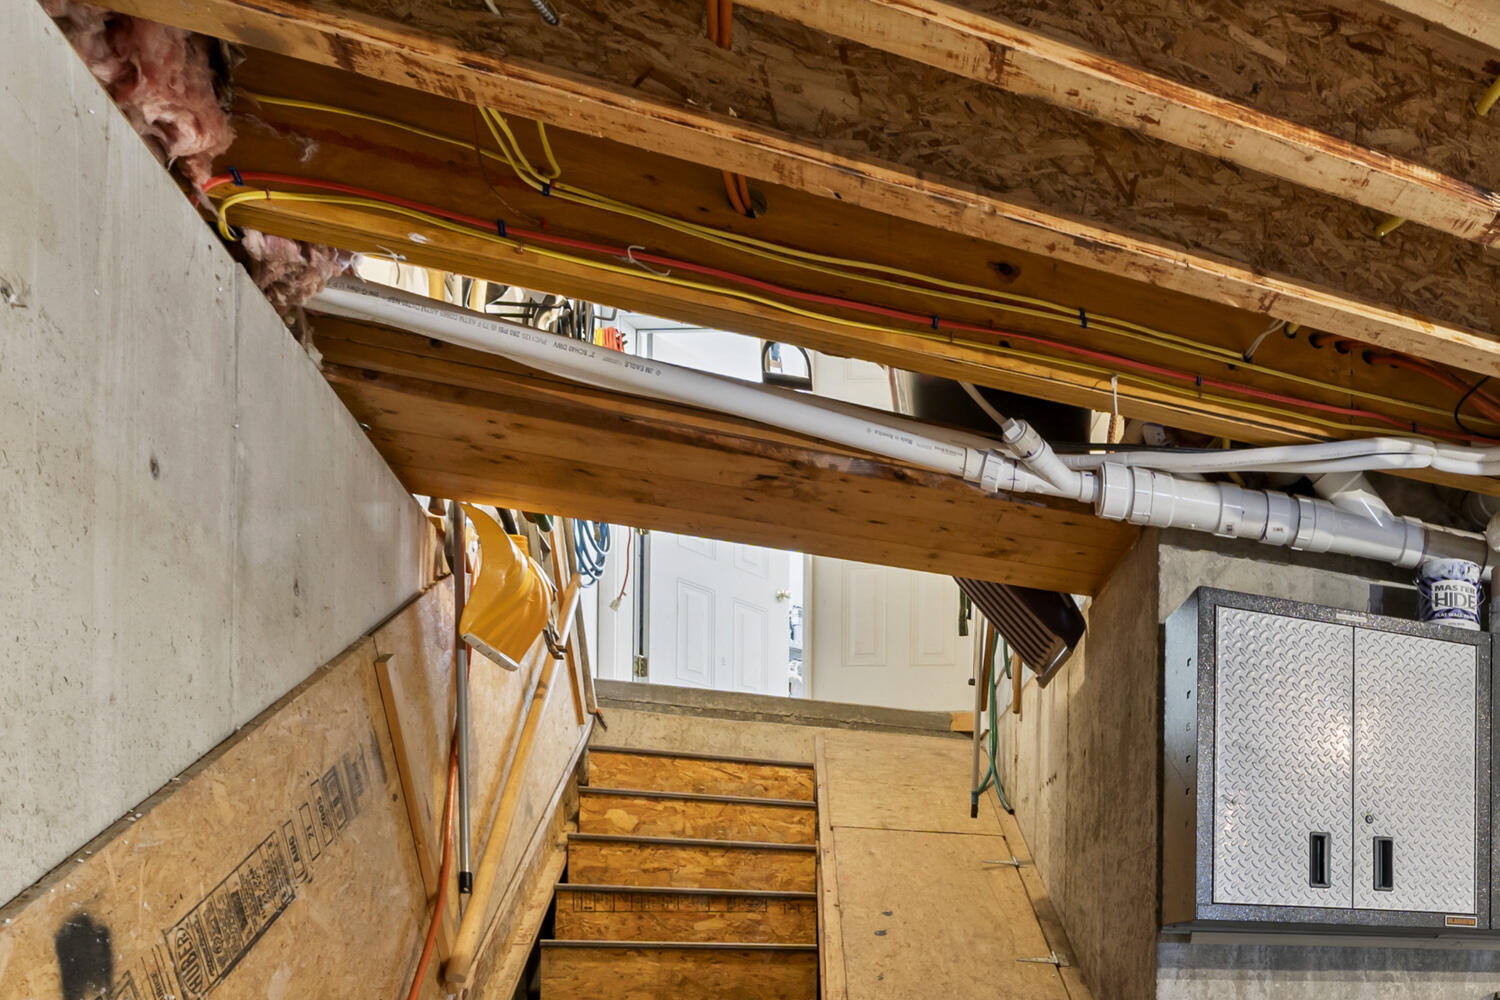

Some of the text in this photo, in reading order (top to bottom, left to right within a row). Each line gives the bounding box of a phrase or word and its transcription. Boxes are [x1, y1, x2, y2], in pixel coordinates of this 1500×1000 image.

[1434, 584, 1476, 594] MASTER
[1434, 592, 1476, 610] HIDE
[289, 835, 300, 863] AUG
[177, 931, 202, 993] HUBER
